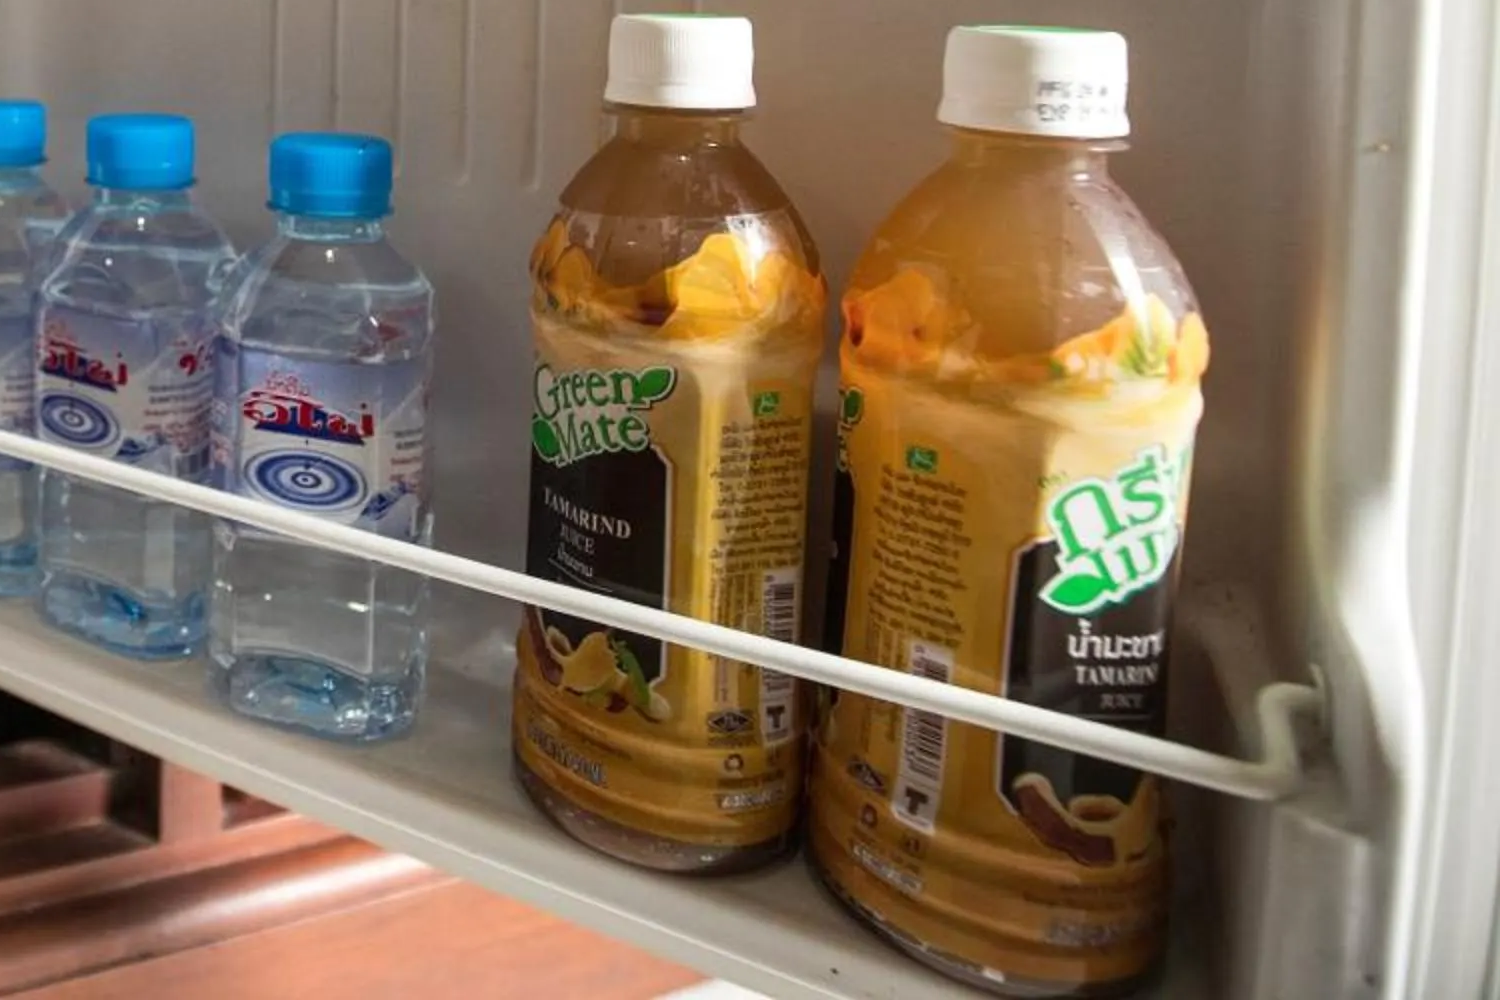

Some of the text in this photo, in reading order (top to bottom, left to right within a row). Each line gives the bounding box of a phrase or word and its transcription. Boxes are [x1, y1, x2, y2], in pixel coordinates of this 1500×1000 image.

[534, 363, 642, 421] Green
[553, 412, 647, 461] Mate
[543, 486, 632, 539] TAMARIND
[1067, 617, 1165, 659] น้ำมะขา
[1074, 662, 1159, 686] TAMARIN
